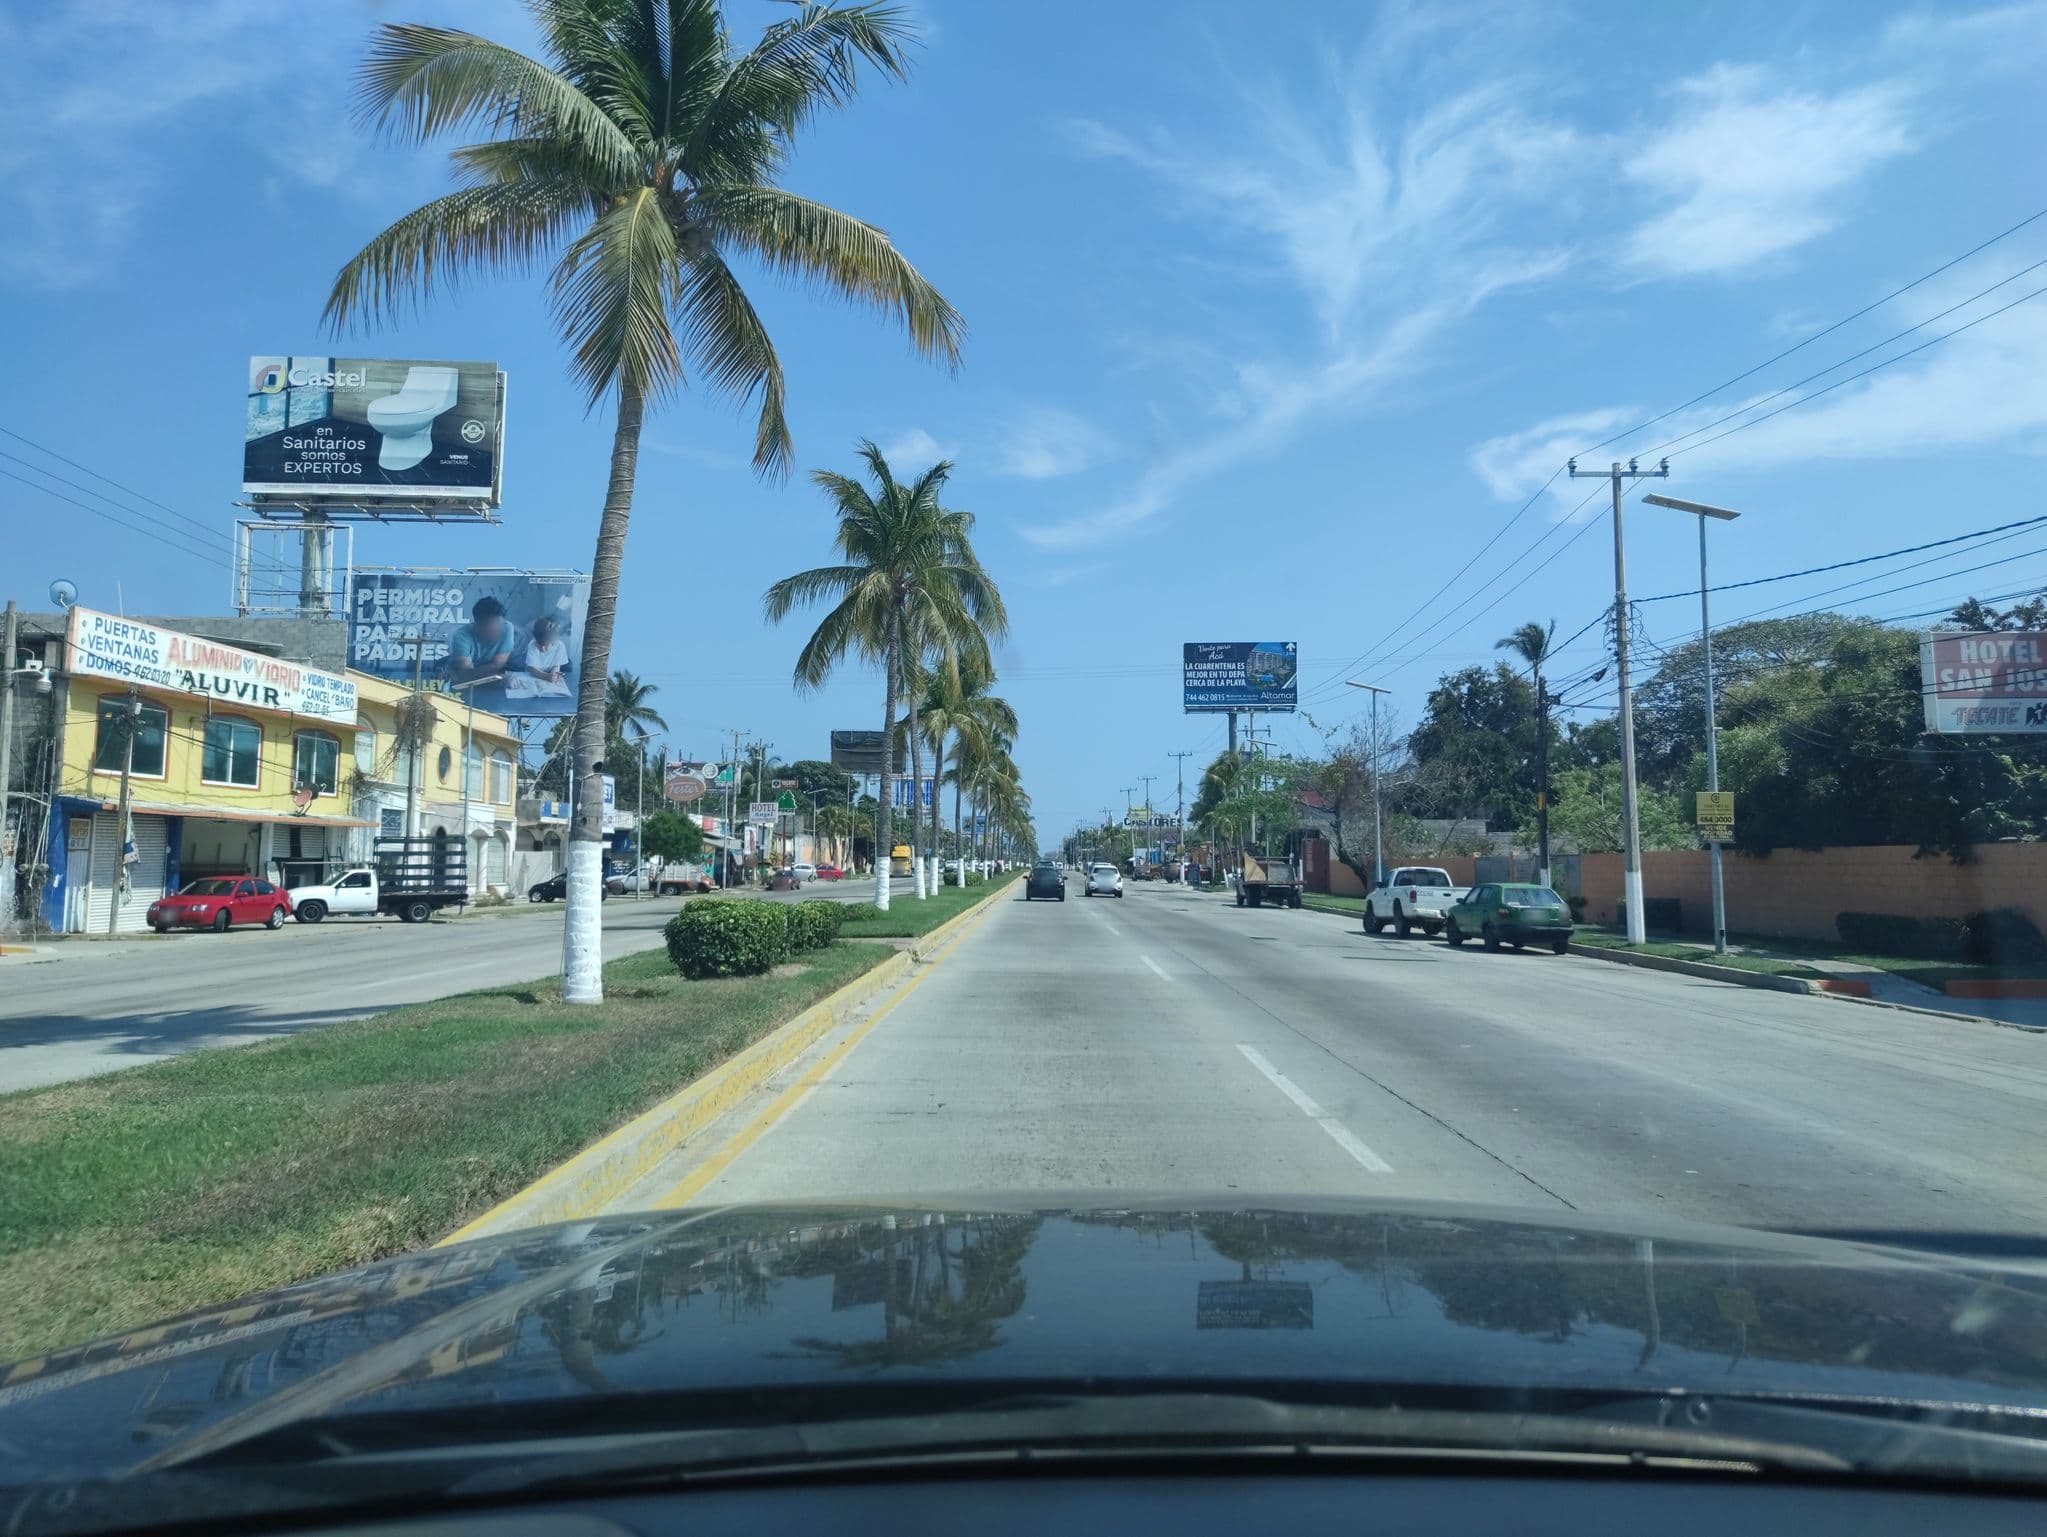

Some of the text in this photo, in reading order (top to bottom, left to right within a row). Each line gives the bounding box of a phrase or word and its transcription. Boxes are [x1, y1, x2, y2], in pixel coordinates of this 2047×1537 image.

[288, 367, 366, 387] Castel
[316, 427, 333, 436] en
[283, 436, 366, 450] Sanitarios
[301, 451, 346, 461] somos
[284, 461, 362, 474] EXPERTOS
[357, 588, 464, 606] PERMISO
[356, 607, 470, 624] LABORAL
[95, 617, 156, 645] PUERTAS
[355, 625, 419, 642] PARA
[88, 633, 159, 664] VENTANAS
[354, 643, 450, 661] PADRES
[1960, 640, 2043, 664] HOTEL
[86, 652, 131, 676] DOMOS
[167, 637, 242, 670] ALUMINIO
[254, 659, 301, 693] VIDRIO
[1185, 662, 1245, 670] LA CUARENTENA ES
[1186, 679, 1247, 687] CERCA DE LA PLAYA
[1940, 668, 1993, 692] SAN
[1261, 691, 1295, 699] Altamar
[751, 803, 776, 812] HOTEL
